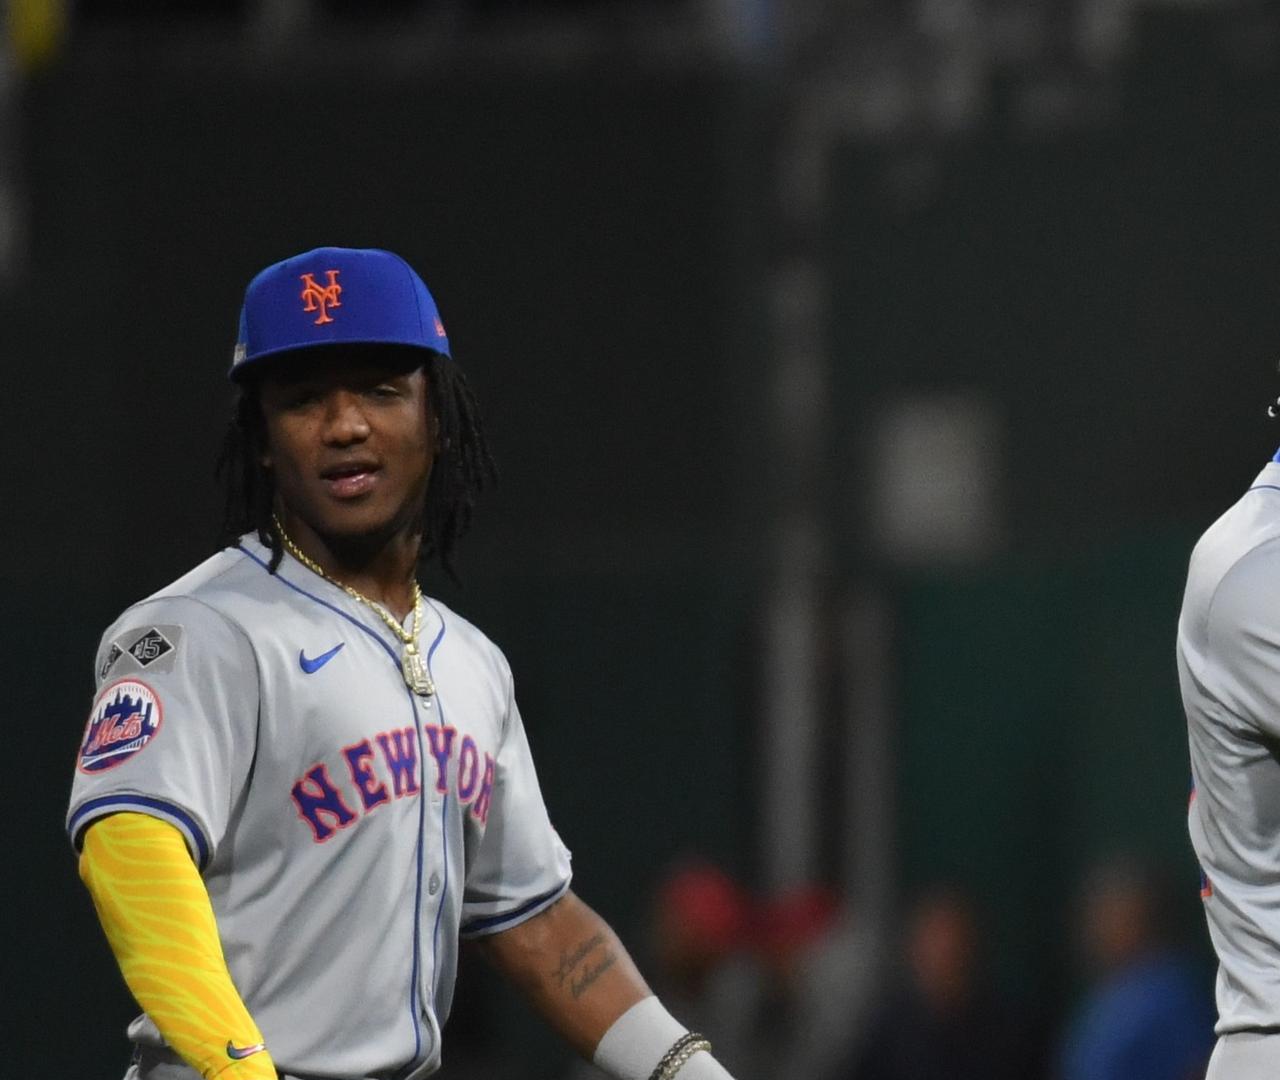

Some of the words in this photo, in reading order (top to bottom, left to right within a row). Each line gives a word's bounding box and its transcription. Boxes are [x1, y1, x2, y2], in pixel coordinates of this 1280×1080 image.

[86, 712, 145, 755] Mets
[291, 726, 421, 844] NEW
[425, 723, 496, 826] YOR
